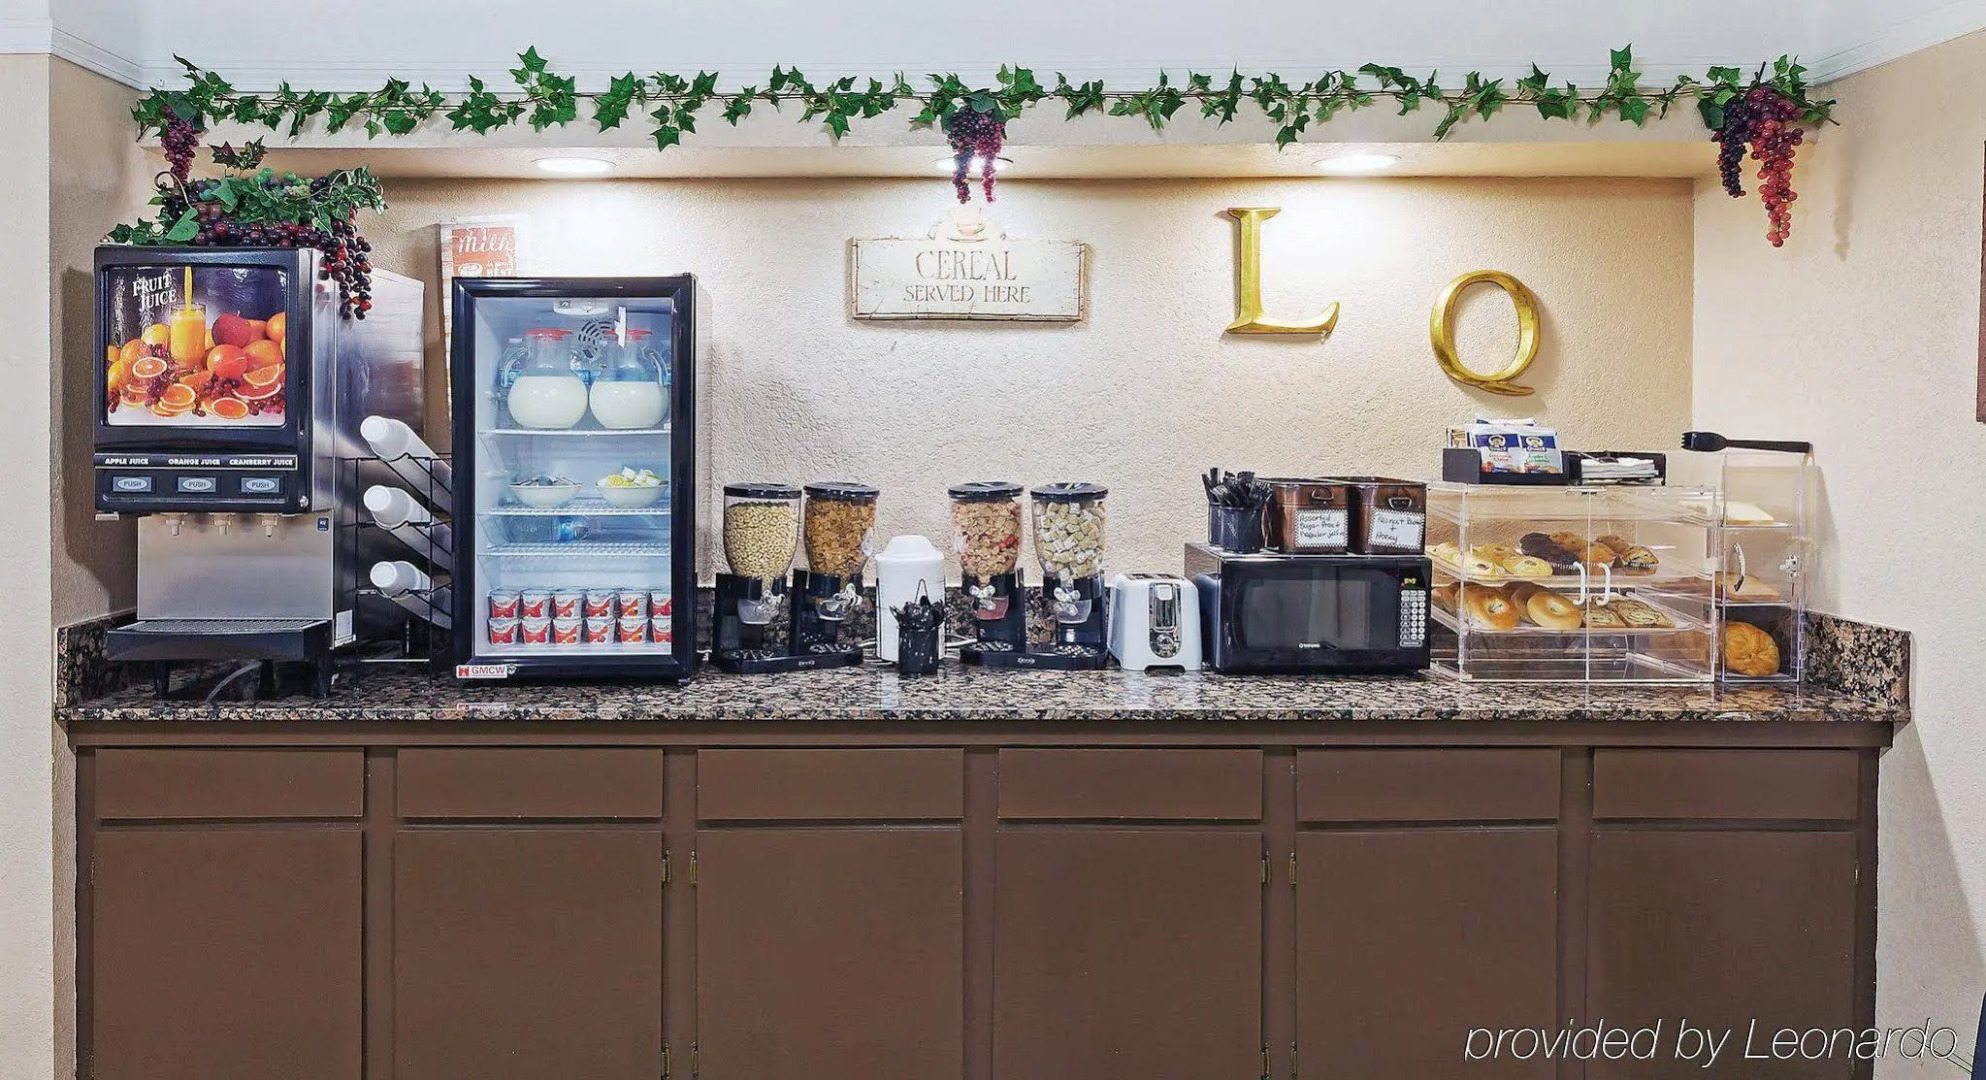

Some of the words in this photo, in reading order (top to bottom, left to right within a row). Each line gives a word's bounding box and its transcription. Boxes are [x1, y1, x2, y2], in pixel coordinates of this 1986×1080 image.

[457, 229, 516, 254] milk
[915, 249, 1018, 281] CEREAL
[1225, 207, 1340, 335] L
[132, 270, 173, 297] FRUIT
[904, 285, 974, 302] SERVED
[984, 286, 1031, 303] HERE
[139, 289, 177, 312] JUICE
[1430, 269, 1541, 396] Q
[168, 458, 200, 466] ORANGE
[201, 458, 221, 466] JUICE
[1375, 531, 1398, 543] Honey
[471, 666, 506, 675] GMCW
